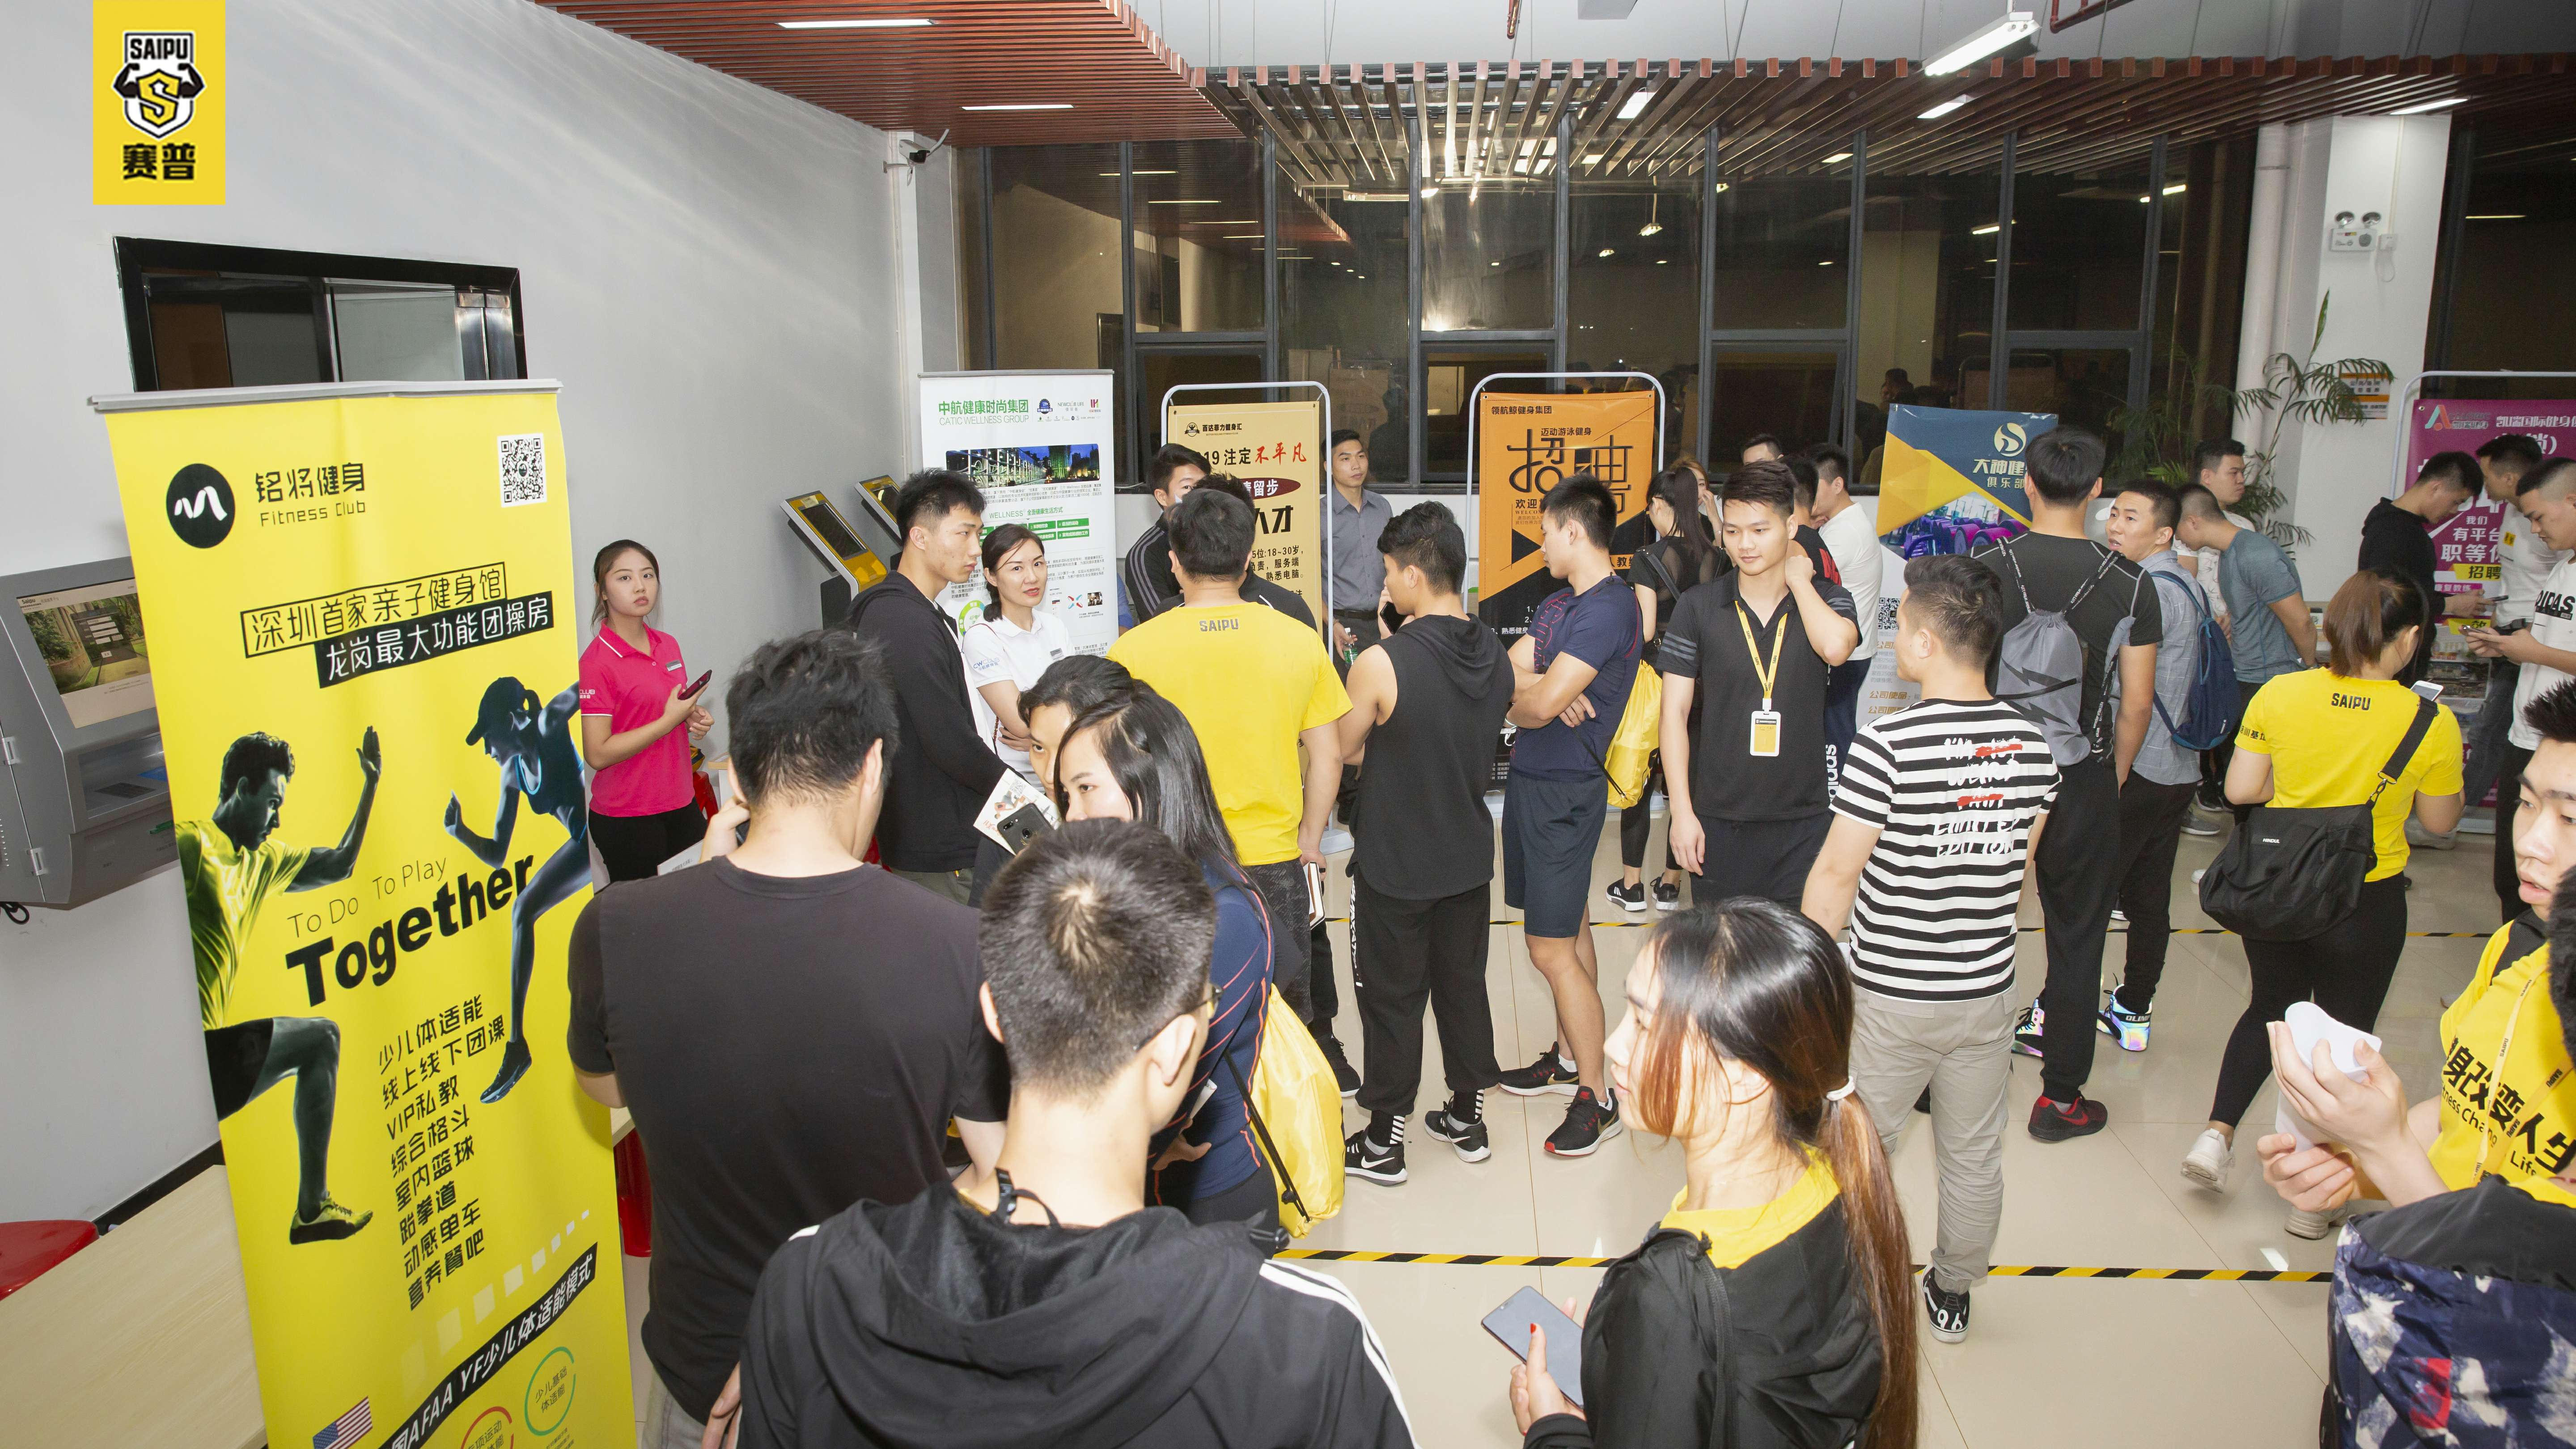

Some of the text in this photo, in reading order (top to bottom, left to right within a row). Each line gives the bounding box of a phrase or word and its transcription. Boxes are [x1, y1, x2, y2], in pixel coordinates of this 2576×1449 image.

[938, 399, 1029, 415] 中航健康时尚集团
[939, 417, 963, 425] CATIC
[963, 415, 1002, 424] WELLNESS
[1003, 415, 1029, 424] GROUP
[1491, 406, 1552, 415] 领航鲸健身集团
[1541, 427, 1592, 436] 迈动游泳健身
[255, 462, 365, 504] 铭将健身
[1973, 458, 2027, 476] 大神健
[259, 500, 366, 527] Fitness Club
[989, 510, 1023, 519] WELLNESS
[2466, 516, 2487, 525] 我们
[2468, 566, 2501, 579] 招聘
[252, 568, 501, 652] 深圳首家亲子健身馆
[1199, 618, 1239, 632] SAIPU
[326, 596, 549, 682] 龙岗最大功能团操房
[2331, 692, 2371, 711] SAIPU
[287, 857, 448, 938] To Do To Play
[285, 855, 534, 1008] Together
[379, 994, 483, 1076] 少儿体适能
[382, 1013, 505, 1110] 线上线下团课
[386, 1075, 460, 1141] VIP私教
[390, 1103, 471, 1178] 综合格斗
[395, 1134, 476, 1212] 室内篮球
[398, 1180, 457, 1246] 跆拳道
[404, 1197, 482, 1279] 动感单车
[407, 1228, 486, 1312] 营养餐吧
[541, 1383, 565, 1413] 体适能
